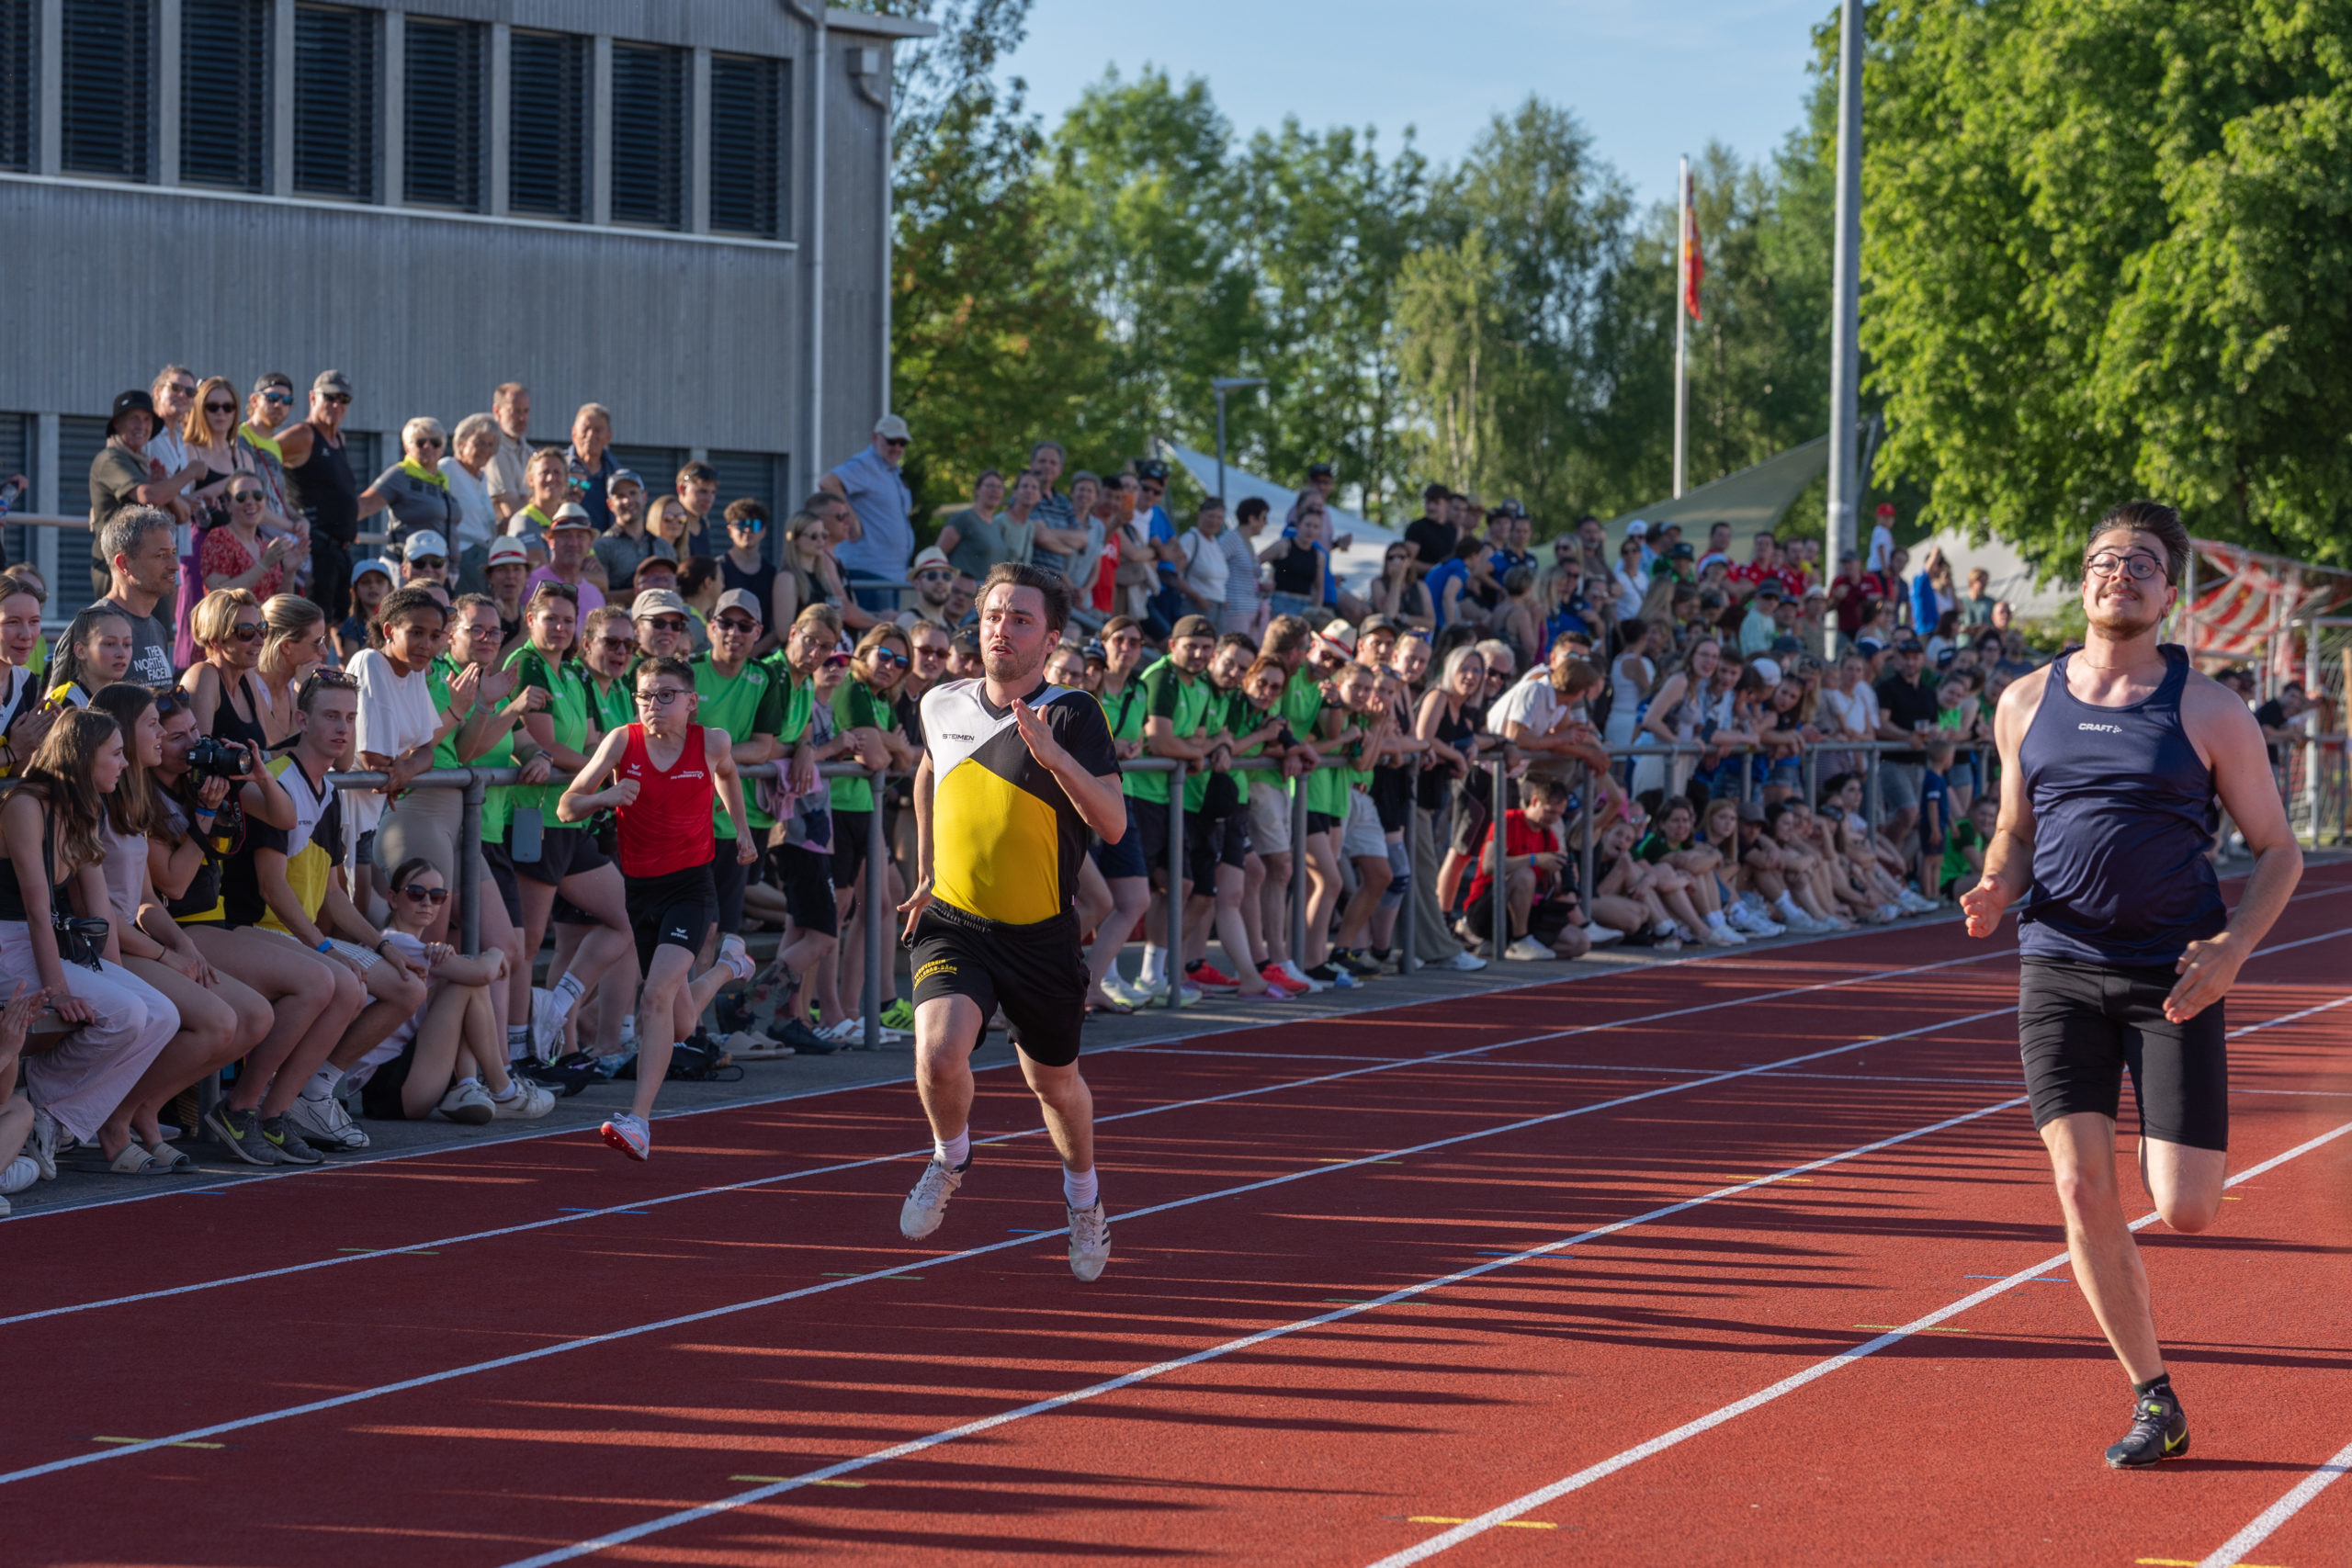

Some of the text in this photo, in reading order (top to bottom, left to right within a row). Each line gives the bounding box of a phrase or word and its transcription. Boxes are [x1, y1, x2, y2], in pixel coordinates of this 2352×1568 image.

[144, 645, 162, 658] THE
[133, 656, 164, 671] NORTH
[147, 667, 166, 681] FACE
[2078, 722, 2113, 732] CRAFT
